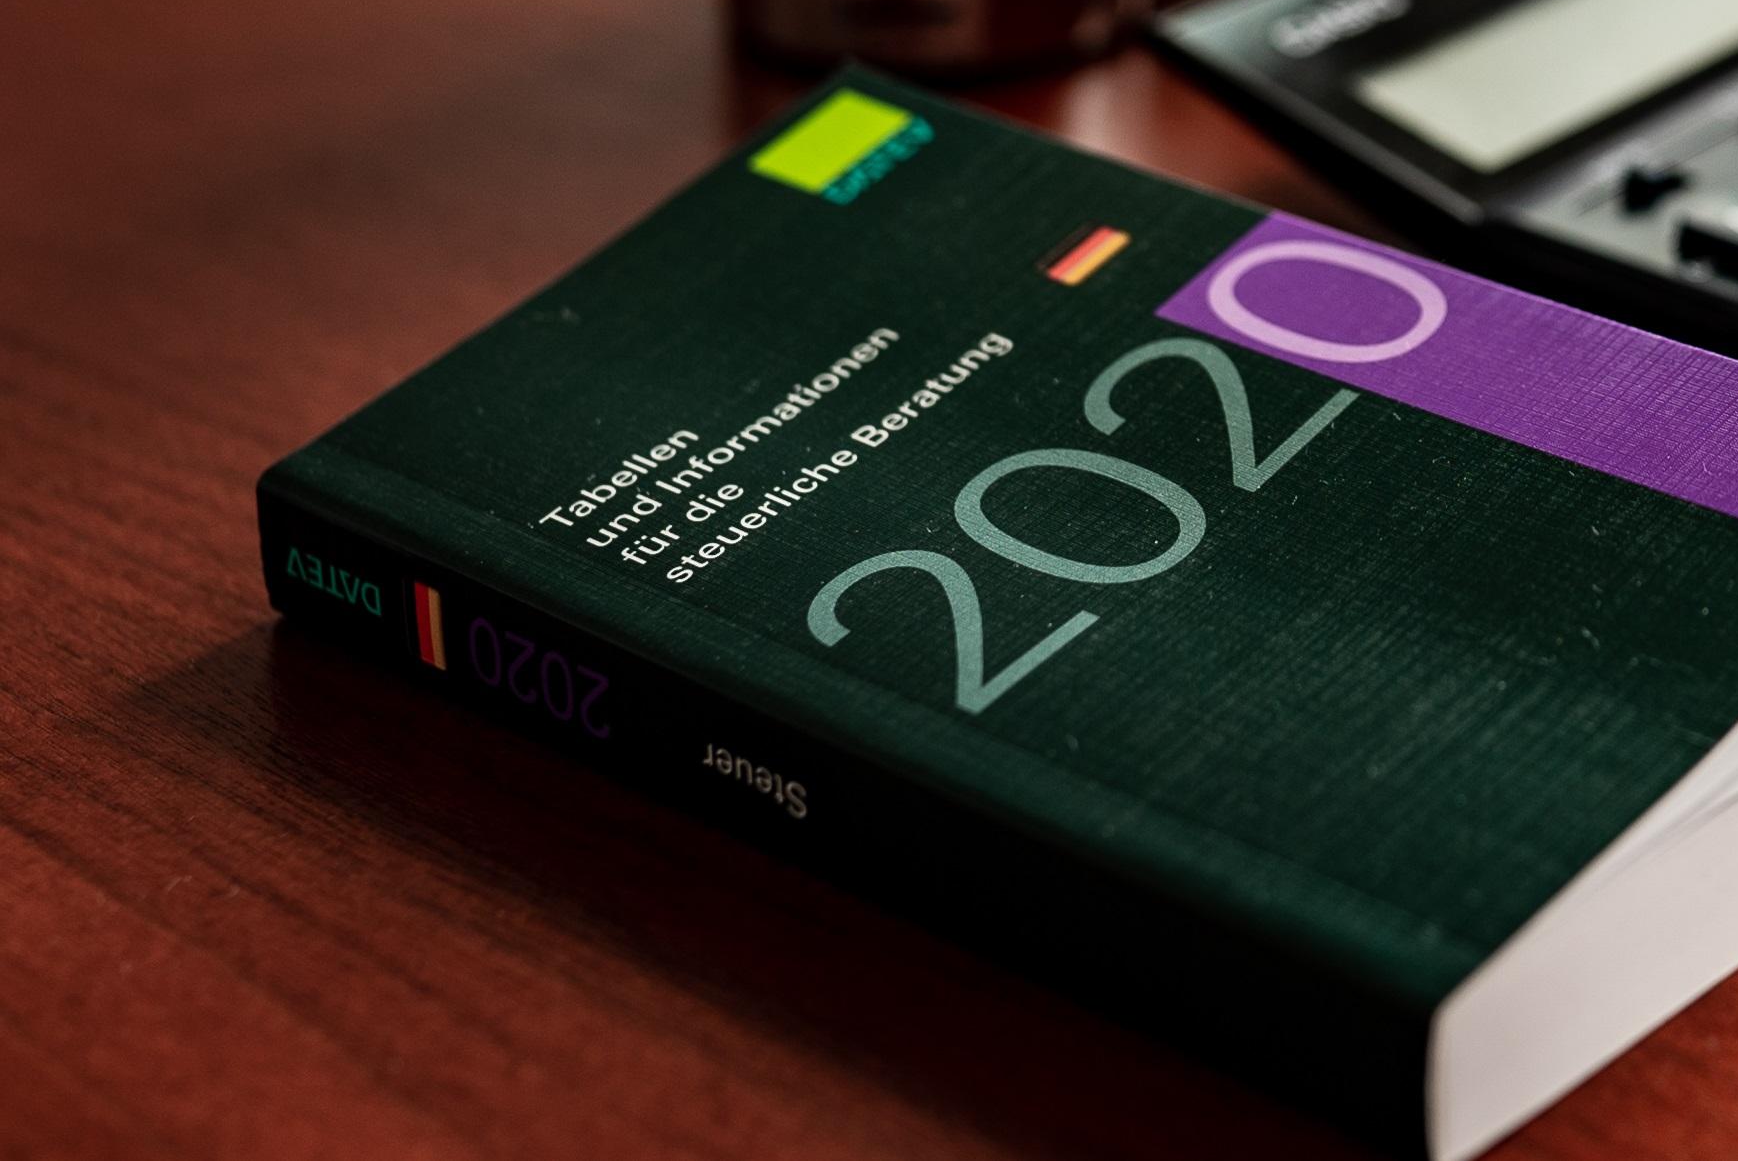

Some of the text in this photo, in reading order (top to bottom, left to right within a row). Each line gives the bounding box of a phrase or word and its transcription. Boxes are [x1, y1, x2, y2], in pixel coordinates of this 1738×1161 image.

[539, 427, 699, 531] Tabellen
[586, 326, 900, 548] und Informationen
[666, 332, 1015, 585] steuerliche Beratung
[807, 240, 1447, 715] 2020
[621, 480, 744, 565] für die
[287, 548, 382, 616] DATEV
[468, 617, 611, 738] 2020
[702, 742, 808, 819] Steuer
